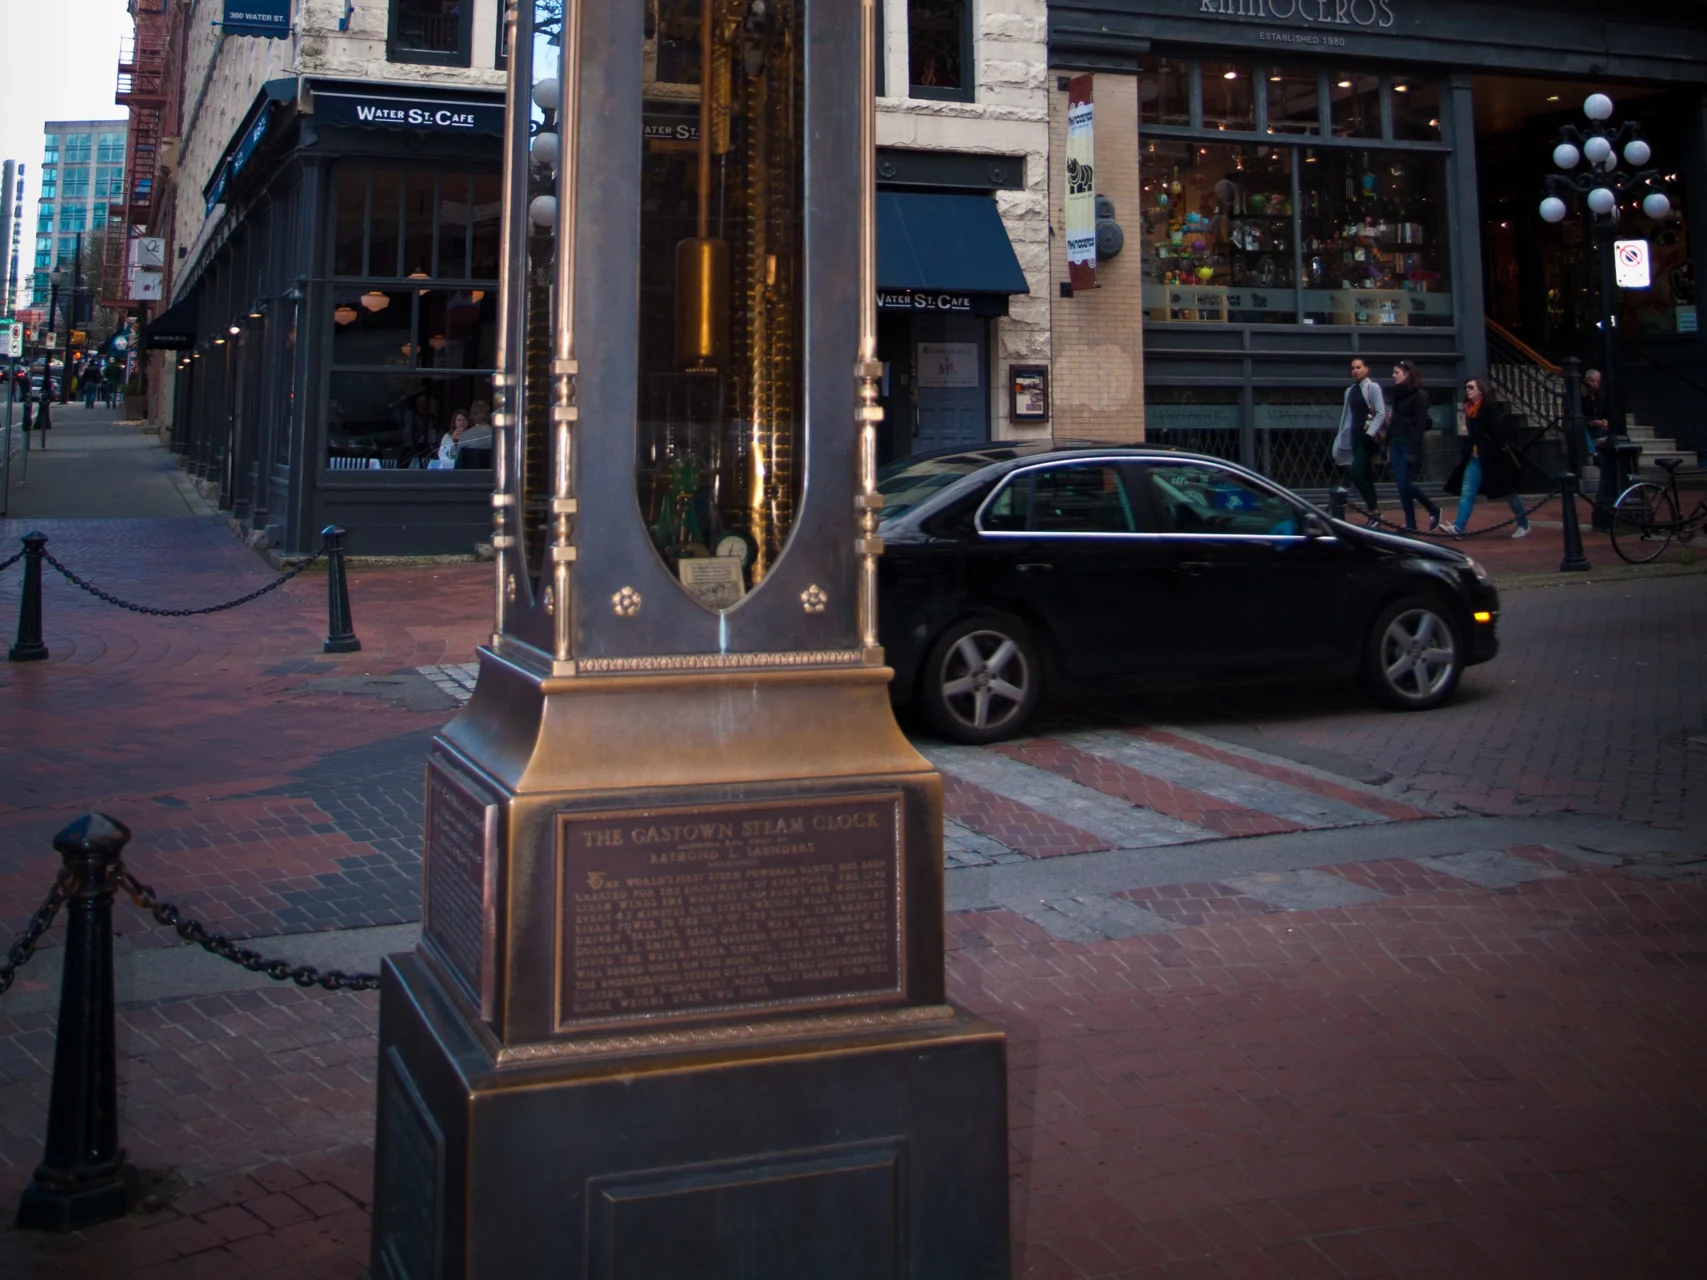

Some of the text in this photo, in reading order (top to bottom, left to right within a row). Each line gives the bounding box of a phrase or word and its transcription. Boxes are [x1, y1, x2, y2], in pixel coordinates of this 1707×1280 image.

[245, 13, 272, 21] WATER
[1260, 32, 1345, 47] ESTABLISHED 1980
[357, 106, 474, 126] WATER ST. CAFE
[642, 124, 672, 137] ATER
[938, 295, 970, 310] CAFE
[583, 810, 879, 848] THE GASTOWN STEAM CLOCK
[649, 848, 718, 864] RAYMOND
[746, 841, 815, 857] SAUNDERS
